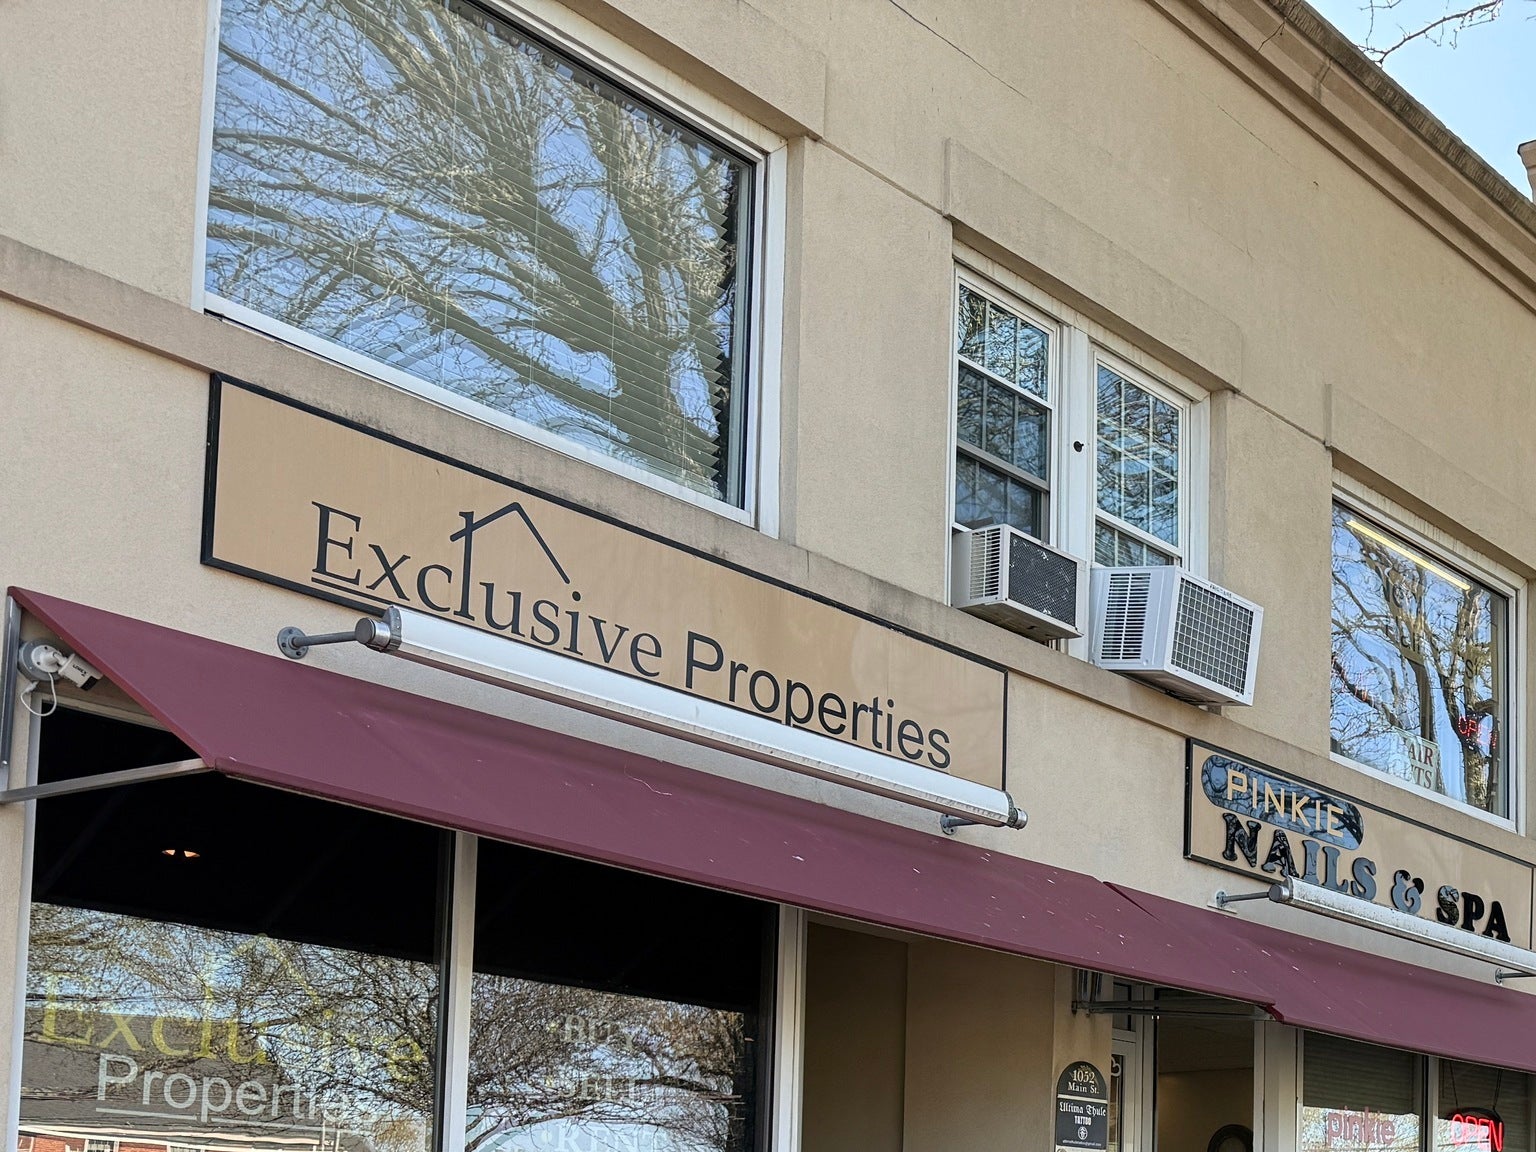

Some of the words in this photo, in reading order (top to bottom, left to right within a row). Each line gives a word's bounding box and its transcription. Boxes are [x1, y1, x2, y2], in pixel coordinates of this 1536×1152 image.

[310, 499, 662, 679] Exclusive
[685, 630, 952, 770] Properties
[1226, 768, 1344, 838] PINKIE
[1222, 812, 1377, 901] NAILS
[1391, 869, 1424, 915] &
[1435, 885, 1511, 943] SPA
[1068, 1082, 1088, 1093] Main
[1090, 1084, 1100, 1094] St.
[1072, 1069, 1095, 1084] 1052
[1059, 1101, 1084, 1114] Ultima
[1086, 1104, 1106, 1117] Thule
[1074, 1115, 1092, 1126] TATTOO
[1326, 1105, 1396, 1148] pinkie
[1451, 1113, 1504, 1152] OPEN
